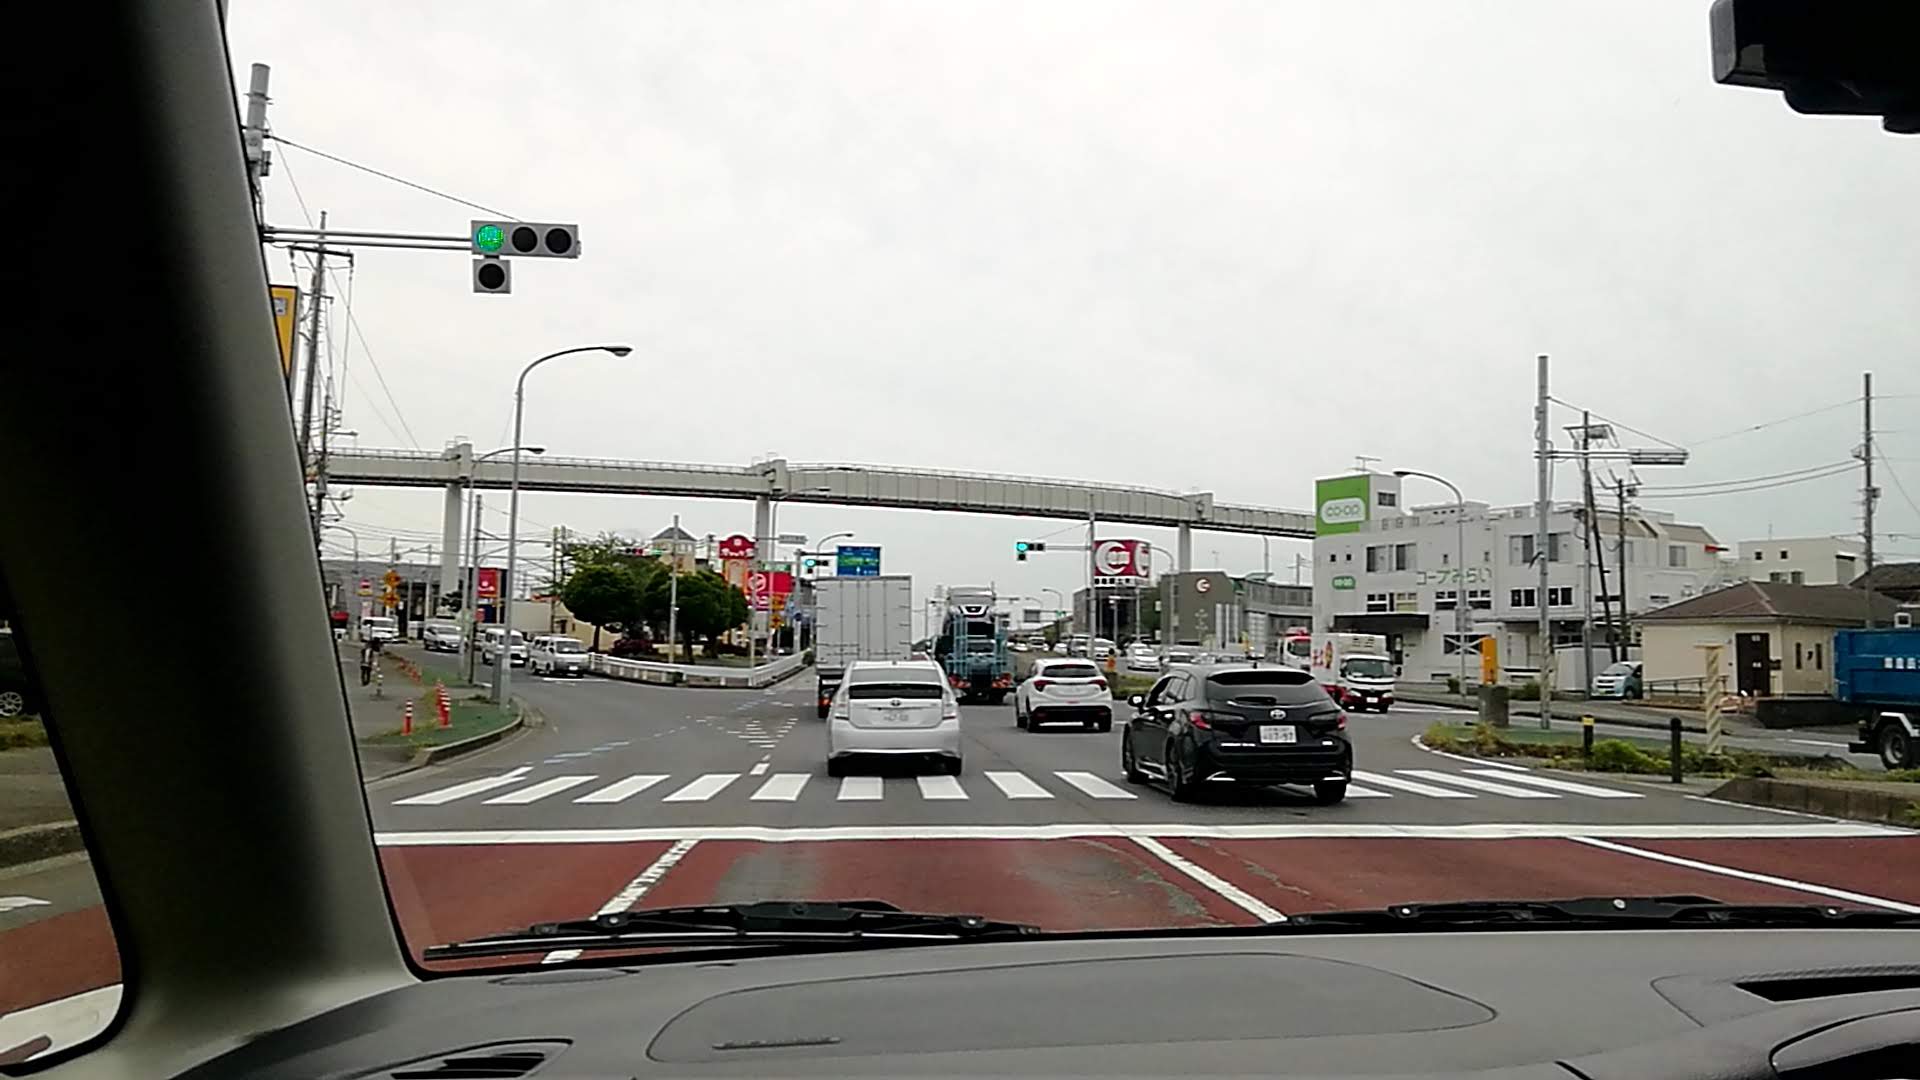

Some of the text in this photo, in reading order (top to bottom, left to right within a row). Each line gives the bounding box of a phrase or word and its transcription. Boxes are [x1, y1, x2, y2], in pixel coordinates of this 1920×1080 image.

[1416, 567, 1492, 587] コープみらい
